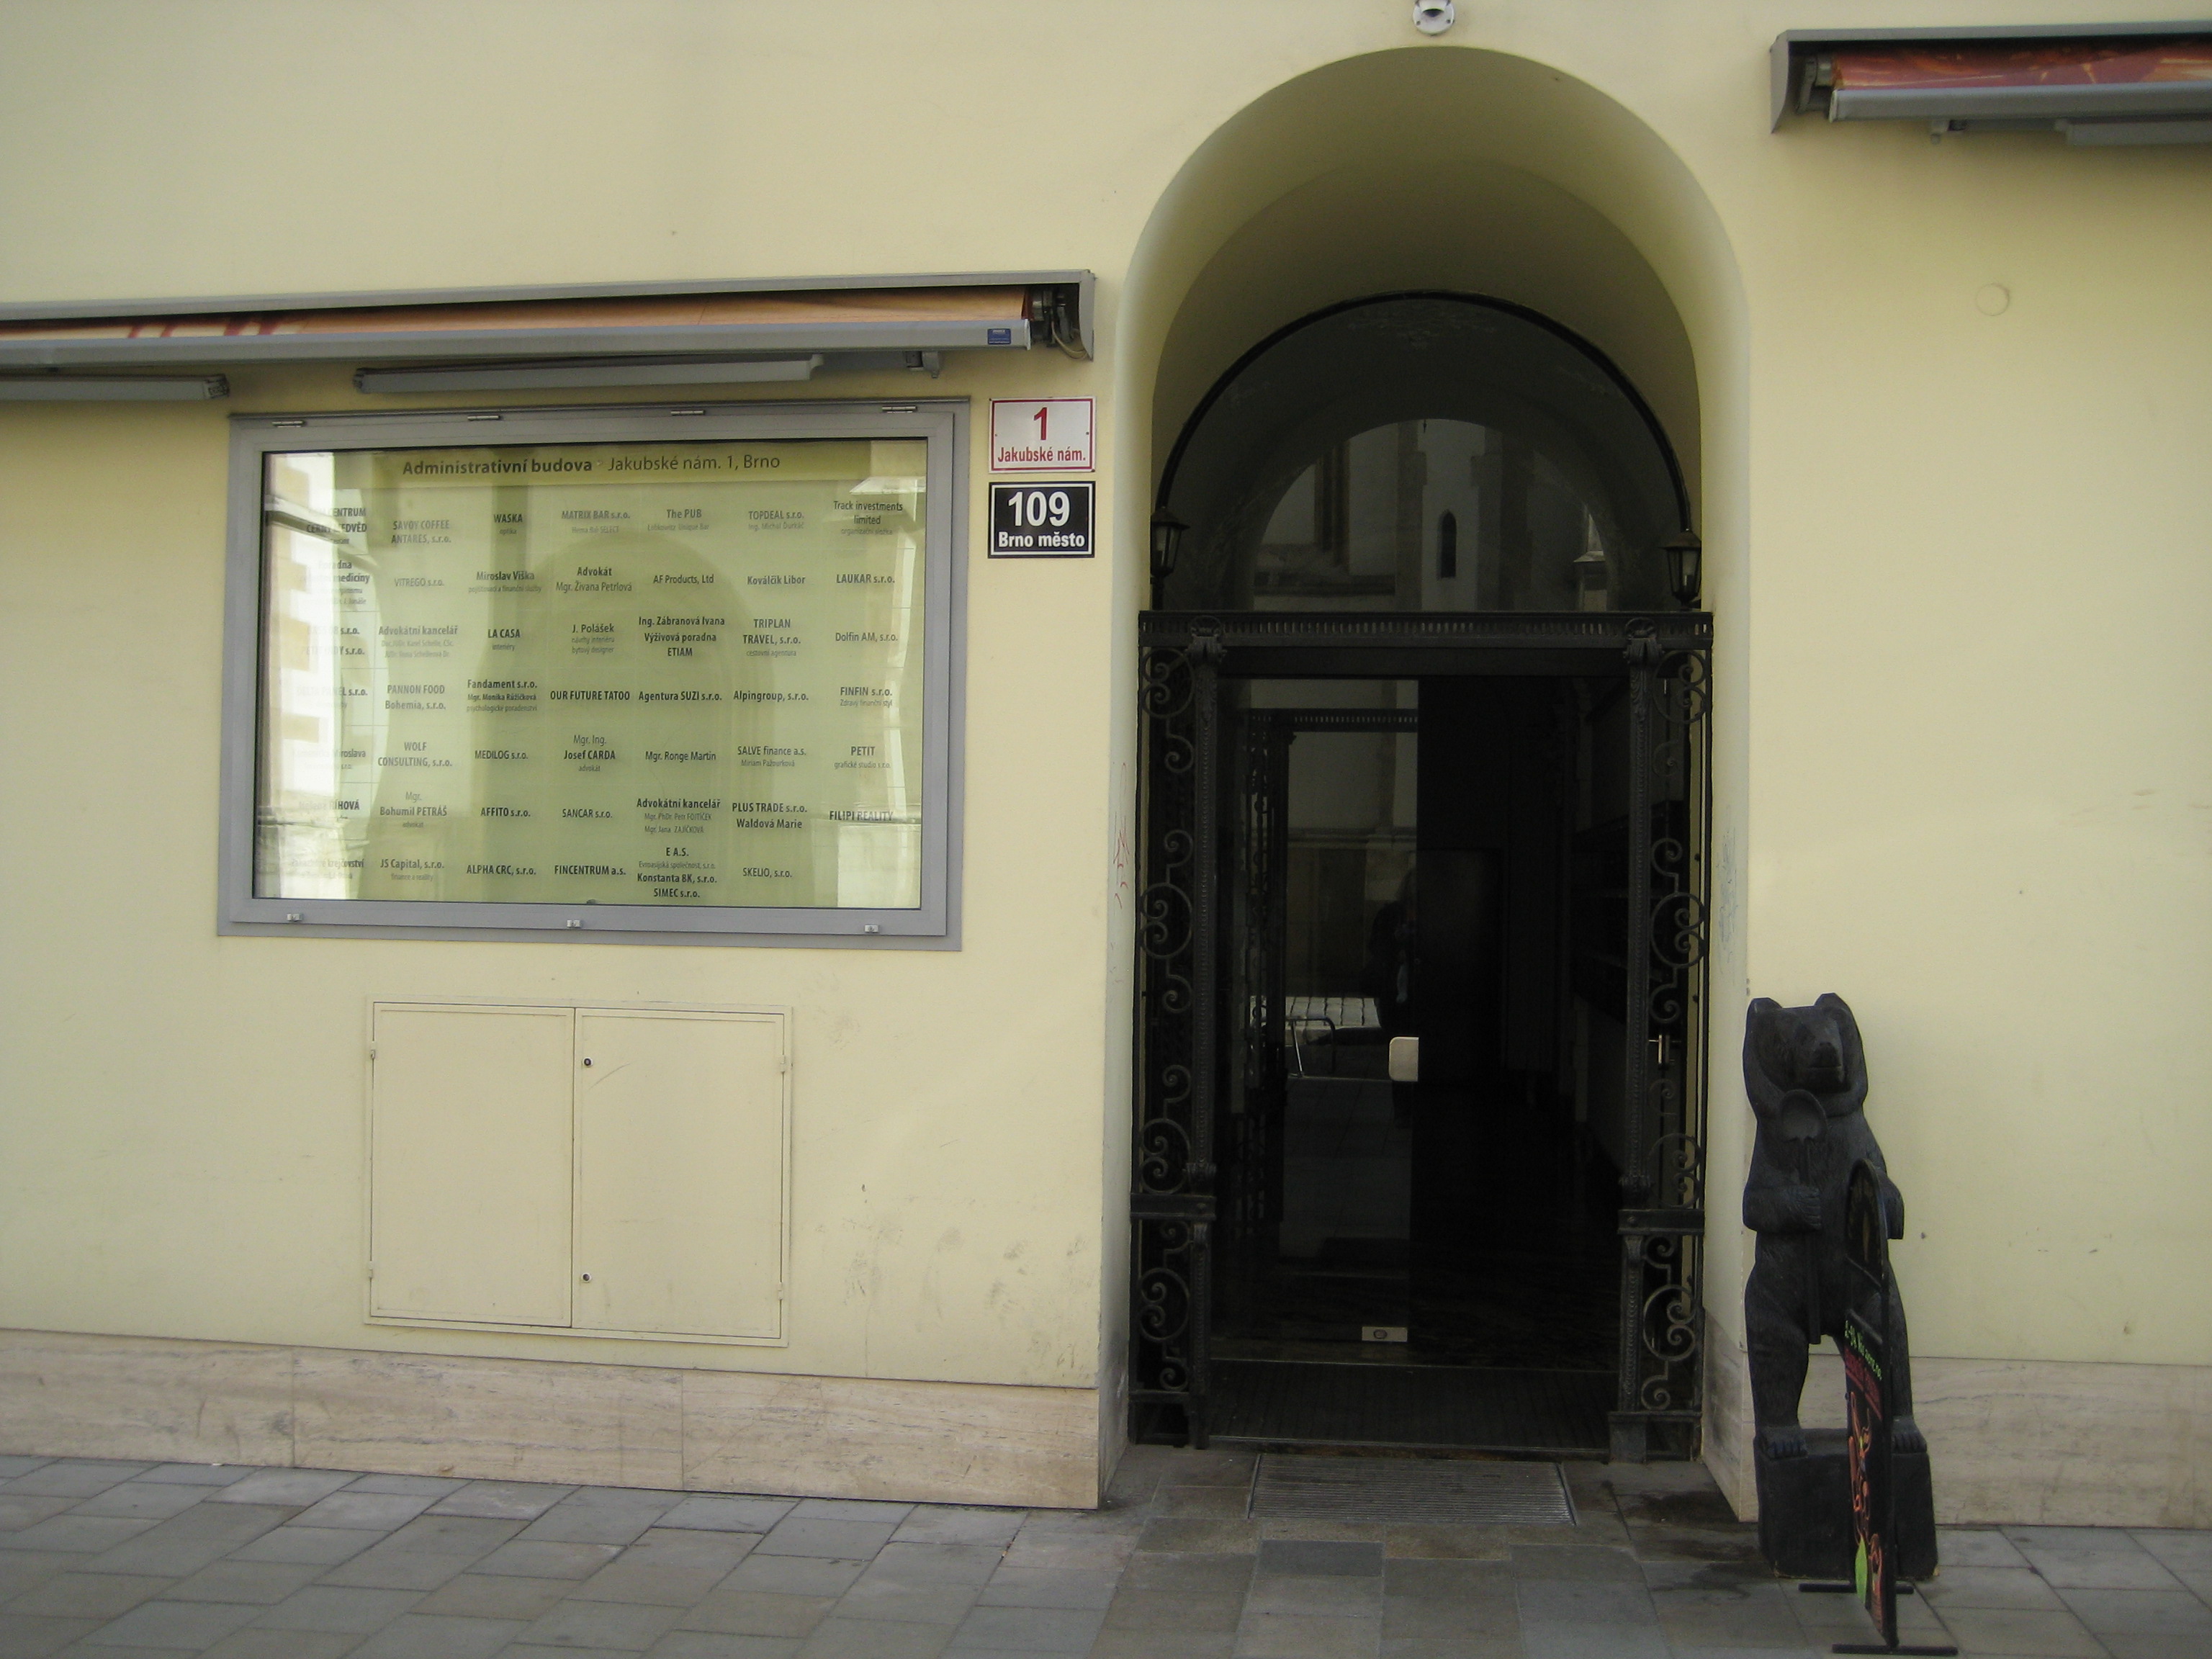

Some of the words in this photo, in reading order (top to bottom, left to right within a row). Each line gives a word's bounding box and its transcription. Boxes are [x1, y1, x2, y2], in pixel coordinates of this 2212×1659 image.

[1034, 407, 1048, 441] 1
[998, 446, 1053, 462] Jakubské
[1058, 446, 1086, 462] nám.
[403, 459, 527, 475] Administrativní
[531, 458, 593, 473] budova
[608, 455, 678, 471] Jakubské
[683, 456, 721, 469] nám.
[727, 455, 738, 471] 1,
[745, 454, 781, 468] Brno
[833, 500, 853, 510] Track
[855, 501, 903, 511] investments
[1008, 491, 1071, 526] 109
[493, 513, 523, 523] WASKA
[562, 511, 590, 519] MATRIX
[593, 511, 609, 519] BAR
[666, 509, 682, 518] The
[684, 509, 702, 518] PUB
[749, 511, 783, 519] TOPDEAL
[392, 520, 418, 530] SAVOY
[421, 520, 450, 529] COFFEE
[854, 516, 881, 524] limited
[998, 531, 1033, 547] Brno
[1038, 531, 1085, 547] město
[477, 571, 511, 580] Miroslav
[513, 570, 535, 580] Viška
[577, 567, 612, 576] Advokát
[665, 575, 700, 585] Products,
[702, 574, 714, 583] Ltd
[783, 575, 806, 584] Libor
[836, 575, 871, 583] LAUKAR
[556, 582, 572, 593] Mgr.
[575, 580, 599, 591] Živana
[639, 617, 655, 627] Ing.
[657, 616, 700, 626] Zábranová
[702, 617, 725, 626] Ivana
[753, 619, 791, 628] TRIPLAN
[379, 626, 421, 634] Advokátní
[422, 625, 458, 634] kancelář
[572, 624, 578, 633] J.
[581, 623, 614, 633] Polášek
[487, 629, 498, 638] LA
[500, 629, 521, 638] CASA
[644, 632, 680, 643] Výživová
[682, 633, 716, 643] poradna
[835, 632, 859, 642] Dolfin
[861, 633, 878, 643] AM,
[742, 634, 778, 645] TRAVEL,
[779, 636, 801, 644] s.r.o.
[667, 647, 693, 657] ETIAM
[467, 679, 516, 688] Fandament
[387, 685, 421, 694] PANNON
[423, 685, 445, 693] FOOD
[840, 687, 868, 696] FINFIN
[550, 691, 568, 701] OUR
[570, 691, 602, 701] FUTURE
[604, 691, 630, 701] TATOO
[639, 691, 678, 702] Agentura
[680, 691, 699, 701] SUZI
[733, 691, 786, 702] Alpingroup,
[788, 692, 809, 701] s.r.o.
[385, 701, 424, 711] Bohemia,
[573, 735, 590, 745] Mgr.
[593, 734, 606, 745] Ing.
[404, 742, 427, 751] WOLF
[737, 746, 761, 755] SALVE
[763, 746, 791, 755] finance
[851, 746, 875, 755] PETIT
[475, 750, 509, 760] MEDILOG
[564, 750, 585, 760] Josef
[588, 750, 616, 760] CARDA
[645, 751, 662, 762] Mgr.
[665, 752, 688, 763] Ronge
[691, 751, 716, 760] Martin
[377, 757, 431, 768] CONSULTING,
[405, 791, 422, 803] Mgr.
[637, 799, 680, 808] Advokátní
[683, 799, 721, 809] kancelář
[732, 803, 754, 813] PLUS
[755, 803, 783, 813] TRADE
[379, 806, 415, 816] Bohumil
[417, 805, 447, 816] PETRÁŠ
[481, 807, 509, 817] AFFITO
[562, 809, 593, 818] SANCAR
[857, 811, 893, 821] REALITY
[736, 819, 775, 828] Waldová
[776, 819, 802, 828] Marie
[666, 848, 670, 856] E
[673, 848, 689, 856] A.S.
[379, 859, 389, 868] JS
[391, 858, 422, 871] Capital,
[467, 866, 494, 875] ALPHA
[495, 866, 513, 876] CRC,
[554, 866, 609, 875] FINCENTRUM
[742, 868, 773, 878] SKELIO,
[637, 873, 680, 882] Konstanta
[654, 888, 678, 897] SIMEC
